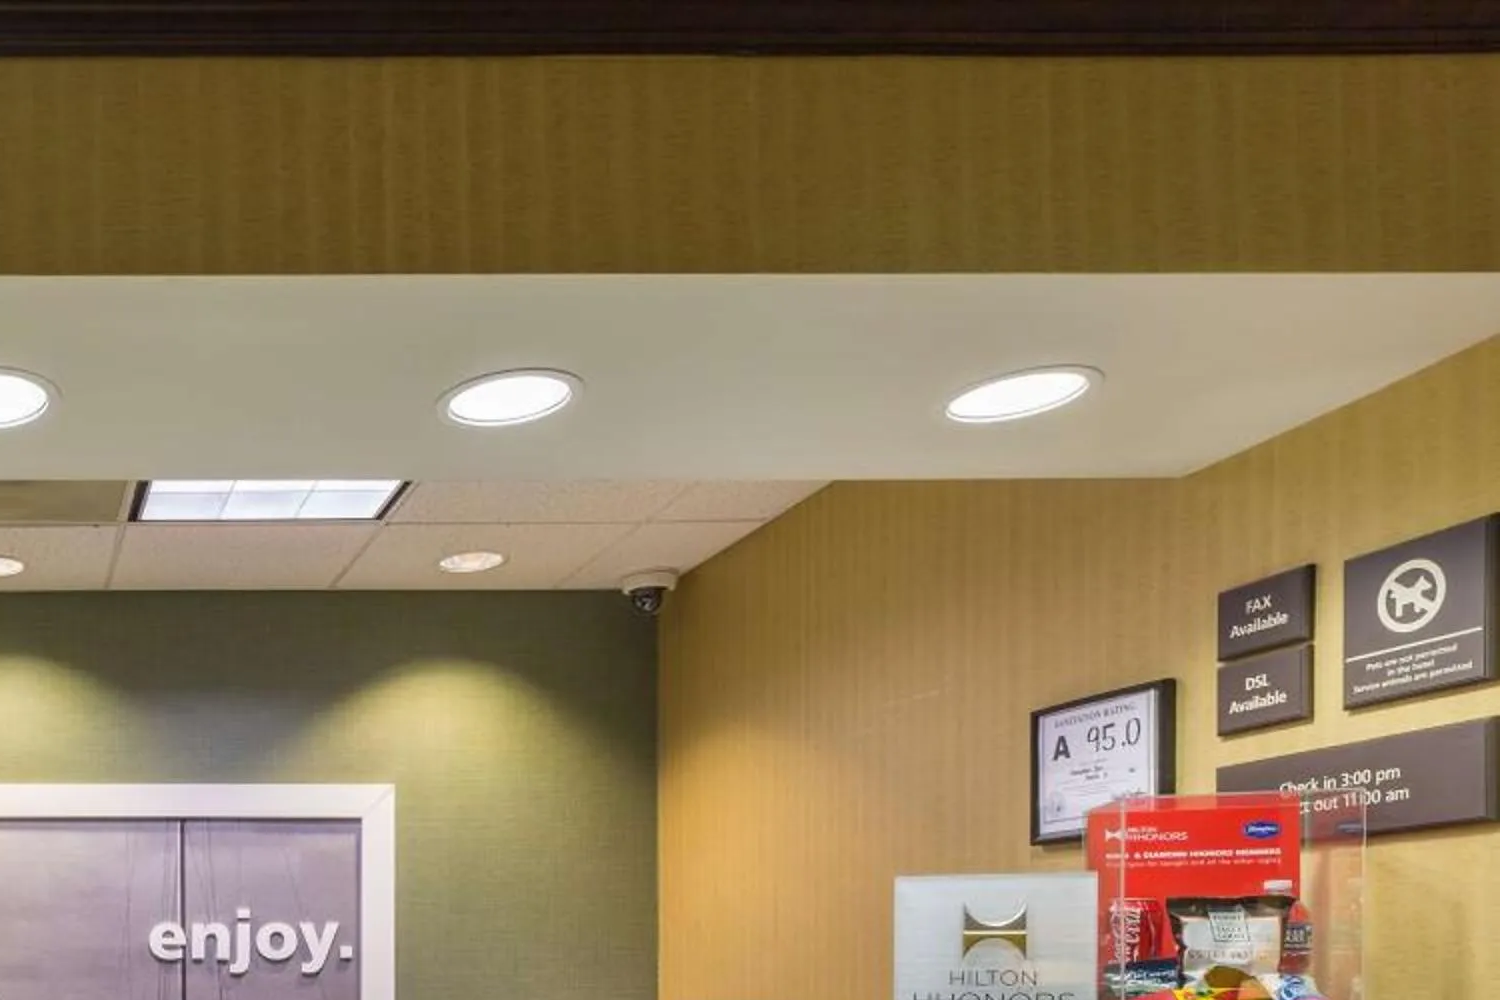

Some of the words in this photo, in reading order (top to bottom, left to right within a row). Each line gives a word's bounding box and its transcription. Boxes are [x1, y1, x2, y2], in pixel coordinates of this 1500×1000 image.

[1246, 595, 1272, 614] FAX
[1229, 612, 1290, 638] Available
[1245, 674, 1270, 690] DSL
[1229, 690, 1288, 715] Available
[1052, 735, 1071, 761] A
[1087, 717, 1142, 753] 95.0
[1279, 777, 1319, 799] Check
[1323, 775, 1337, 790] in
[1340, 769, 1371, 788] 3:00
[1375, 767, 1401, 785] pm
[1385, 788, 1410, 802] am
[149, 908, 353, 975] enjoy.
[949, 969, 1037, 986] HILTON
